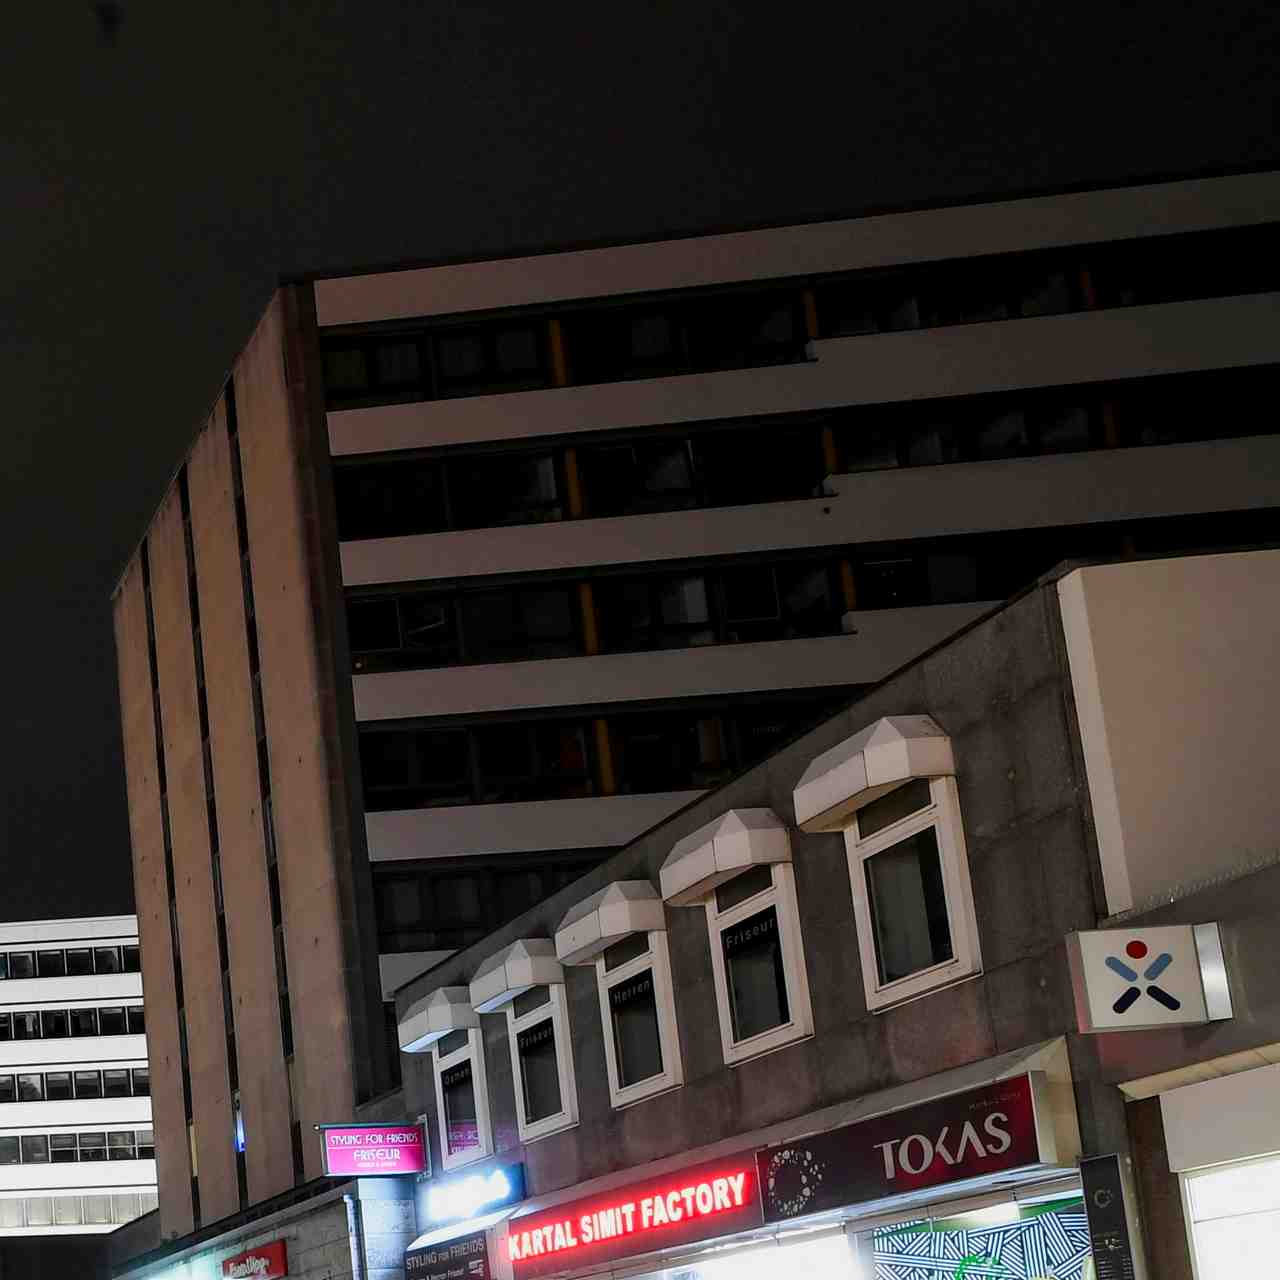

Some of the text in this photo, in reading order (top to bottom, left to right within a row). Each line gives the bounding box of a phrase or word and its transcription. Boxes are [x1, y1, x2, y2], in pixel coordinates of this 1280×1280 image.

[725, 918, 775, 949] Friseur
[330, 1132, 418, 1145] STYLING FOR FRIENDS
[353, 1148, 400, 1161] FRISEUR
[872, 1112, 1012, 1180] TOKAS
[508, 1172, 746, 1261] KARTAL SIMIT FACTORY
[406, 1251, 438, 1270] STYLING
[450, 1237, 485, 1257] FRIENDS
